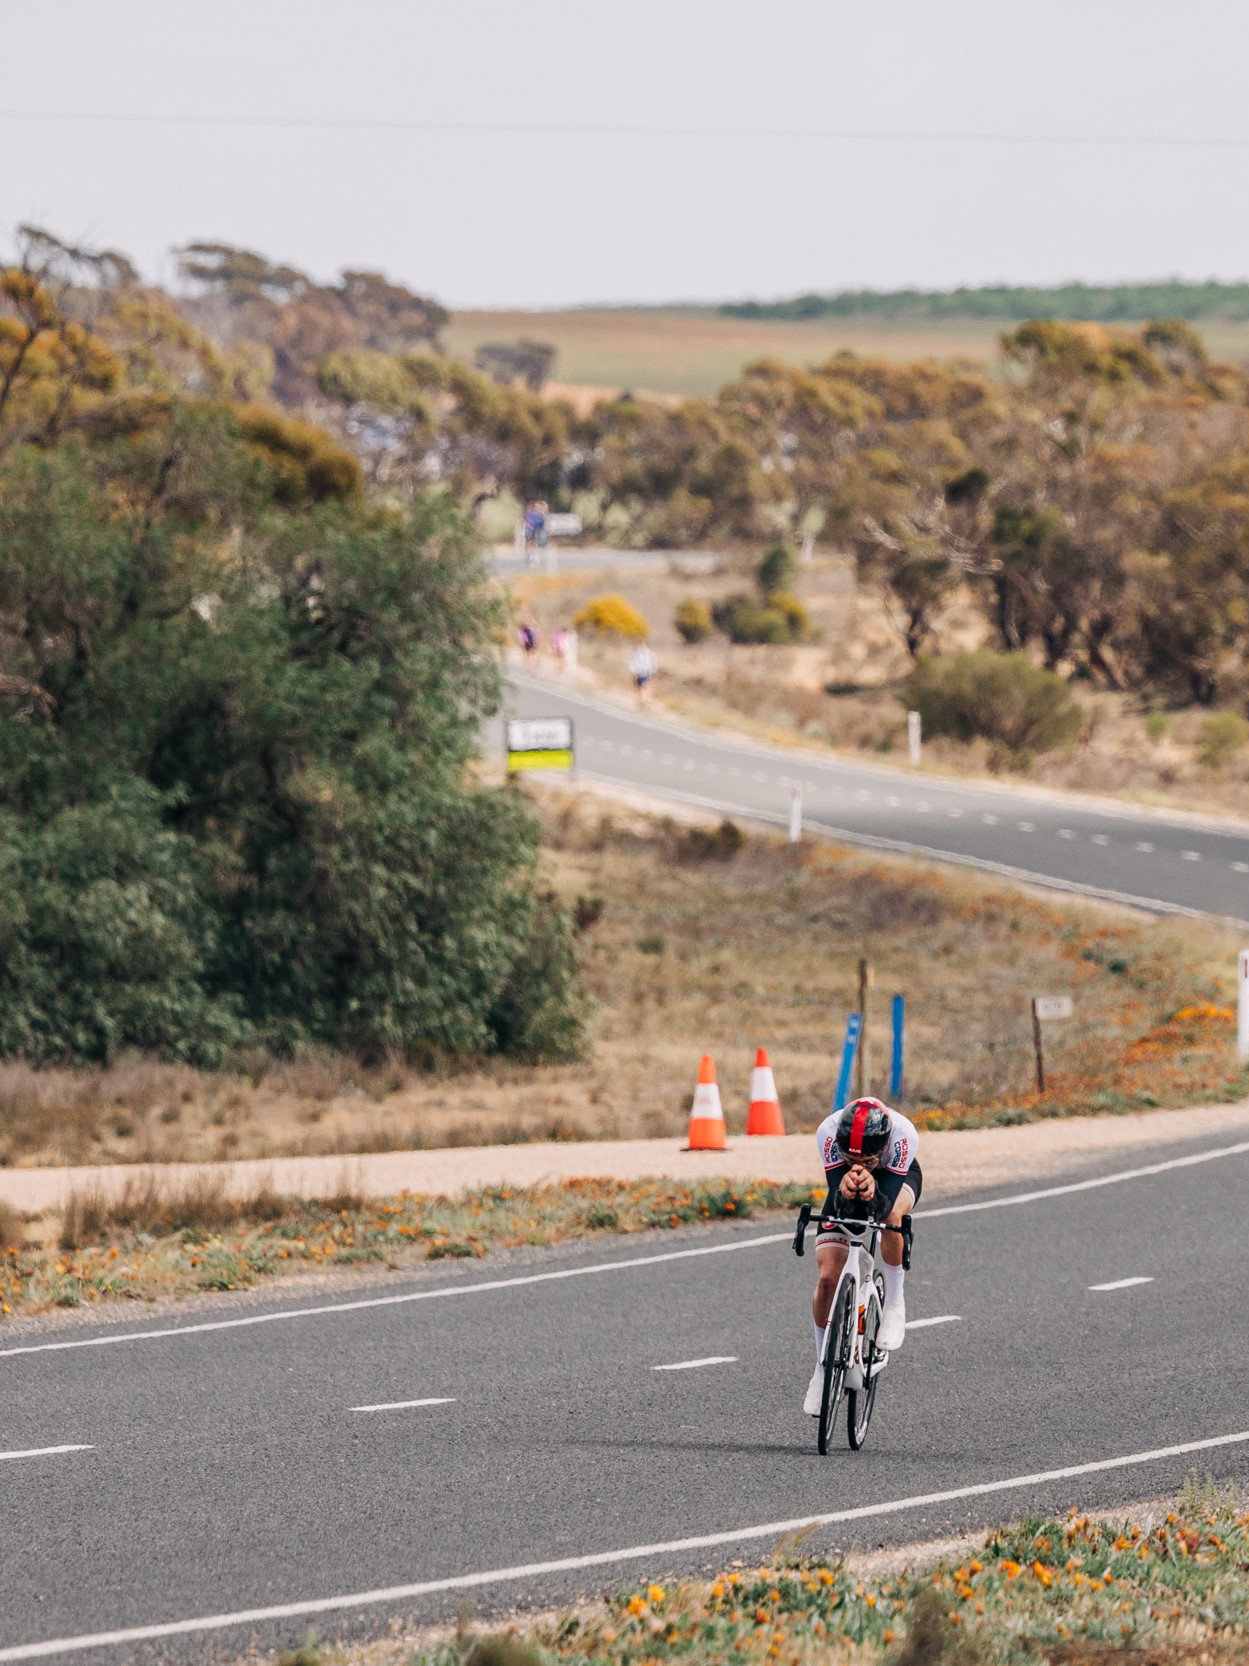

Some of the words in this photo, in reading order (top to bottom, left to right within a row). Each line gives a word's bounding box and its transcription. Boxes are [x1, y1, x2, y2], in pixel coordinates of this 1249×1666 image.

[824, 1136, 833, 1163] ROSSO
[891, 1141, 901, 1168] CORSA
[898, 1138, 908, 1168] ROSSO
